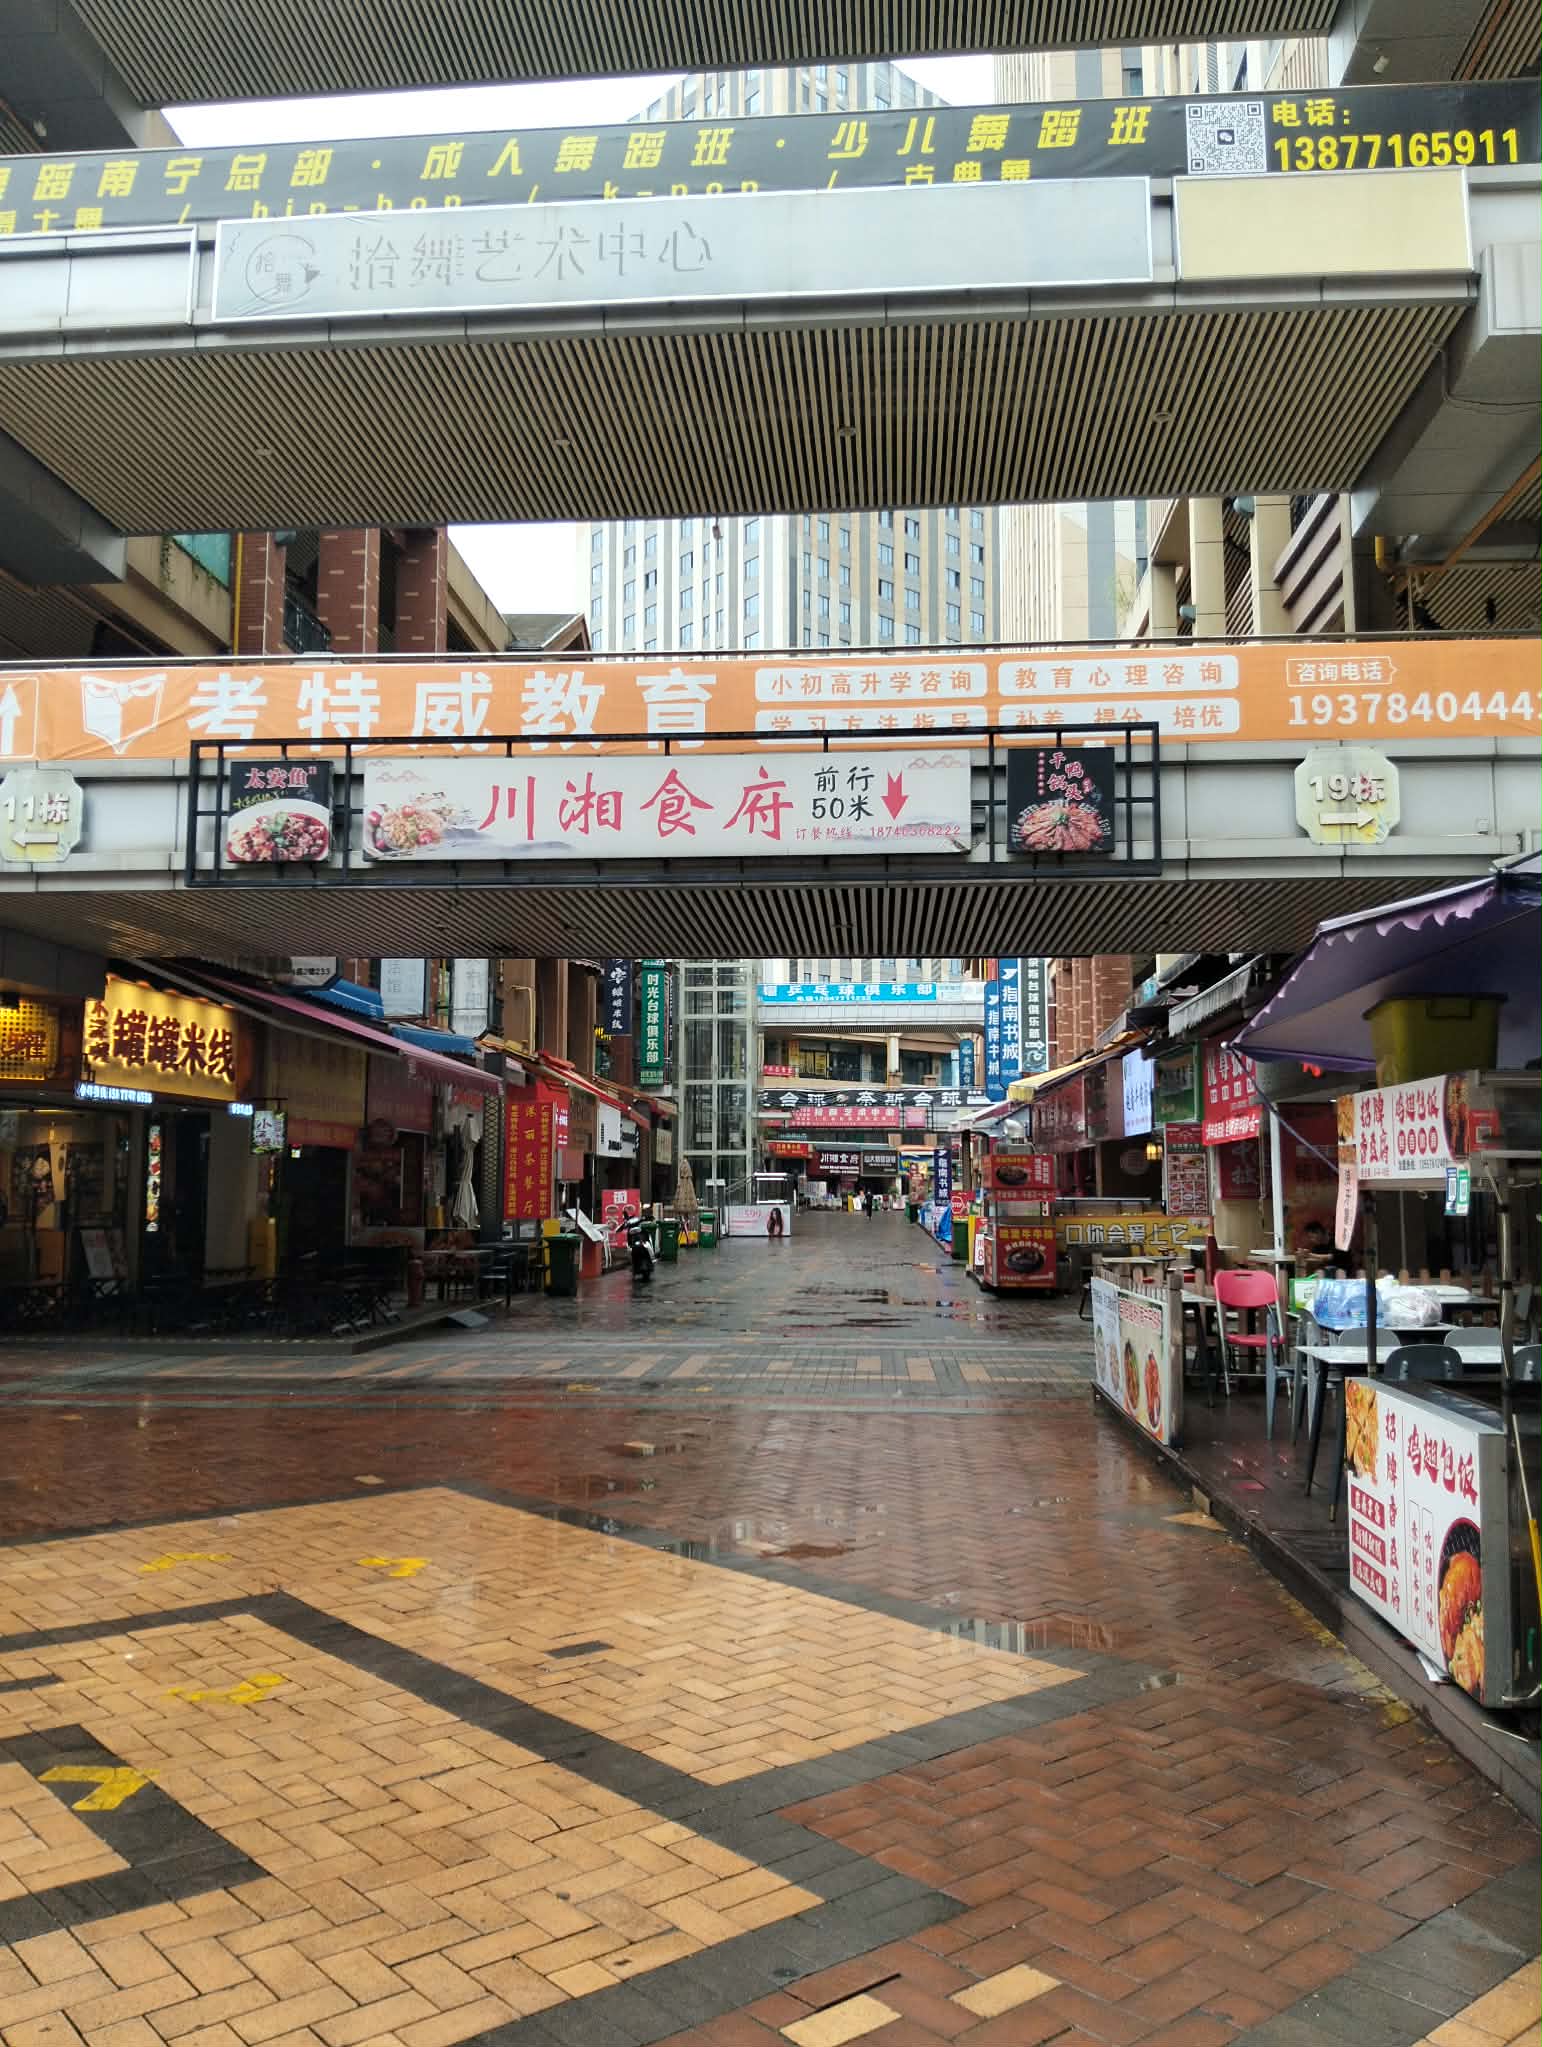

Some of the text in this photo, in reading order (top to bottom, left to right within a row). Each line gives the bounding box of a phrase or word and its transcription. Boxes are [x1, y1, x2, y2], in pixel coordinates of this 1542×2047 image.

[1274, 128, 1519, 173] 13877165911
[770, 662, 1224, 695] 小初高升学咨询 教育心理咨询
[1296, 661, 1384, 683] 咨询电话
[187, 670, 717, 754] 考特威教育
[1172, 705, 1224, 730] 培优
[1287, 690, 1542, 726] 1937840444
[814, 766, 875, 792] 前行
[477, 765, 794, 841] 川湘食府
[812, 795, 875, 821] 50米
[646, 973, 660, 1065] 时光台球俱乐部
[1001, 985, 1019, 1061] 指南书城
[113, 1008, 236, 1083] 罐罐米线
[1406, 1424, 1479, 1507] 鸡翅包饭
